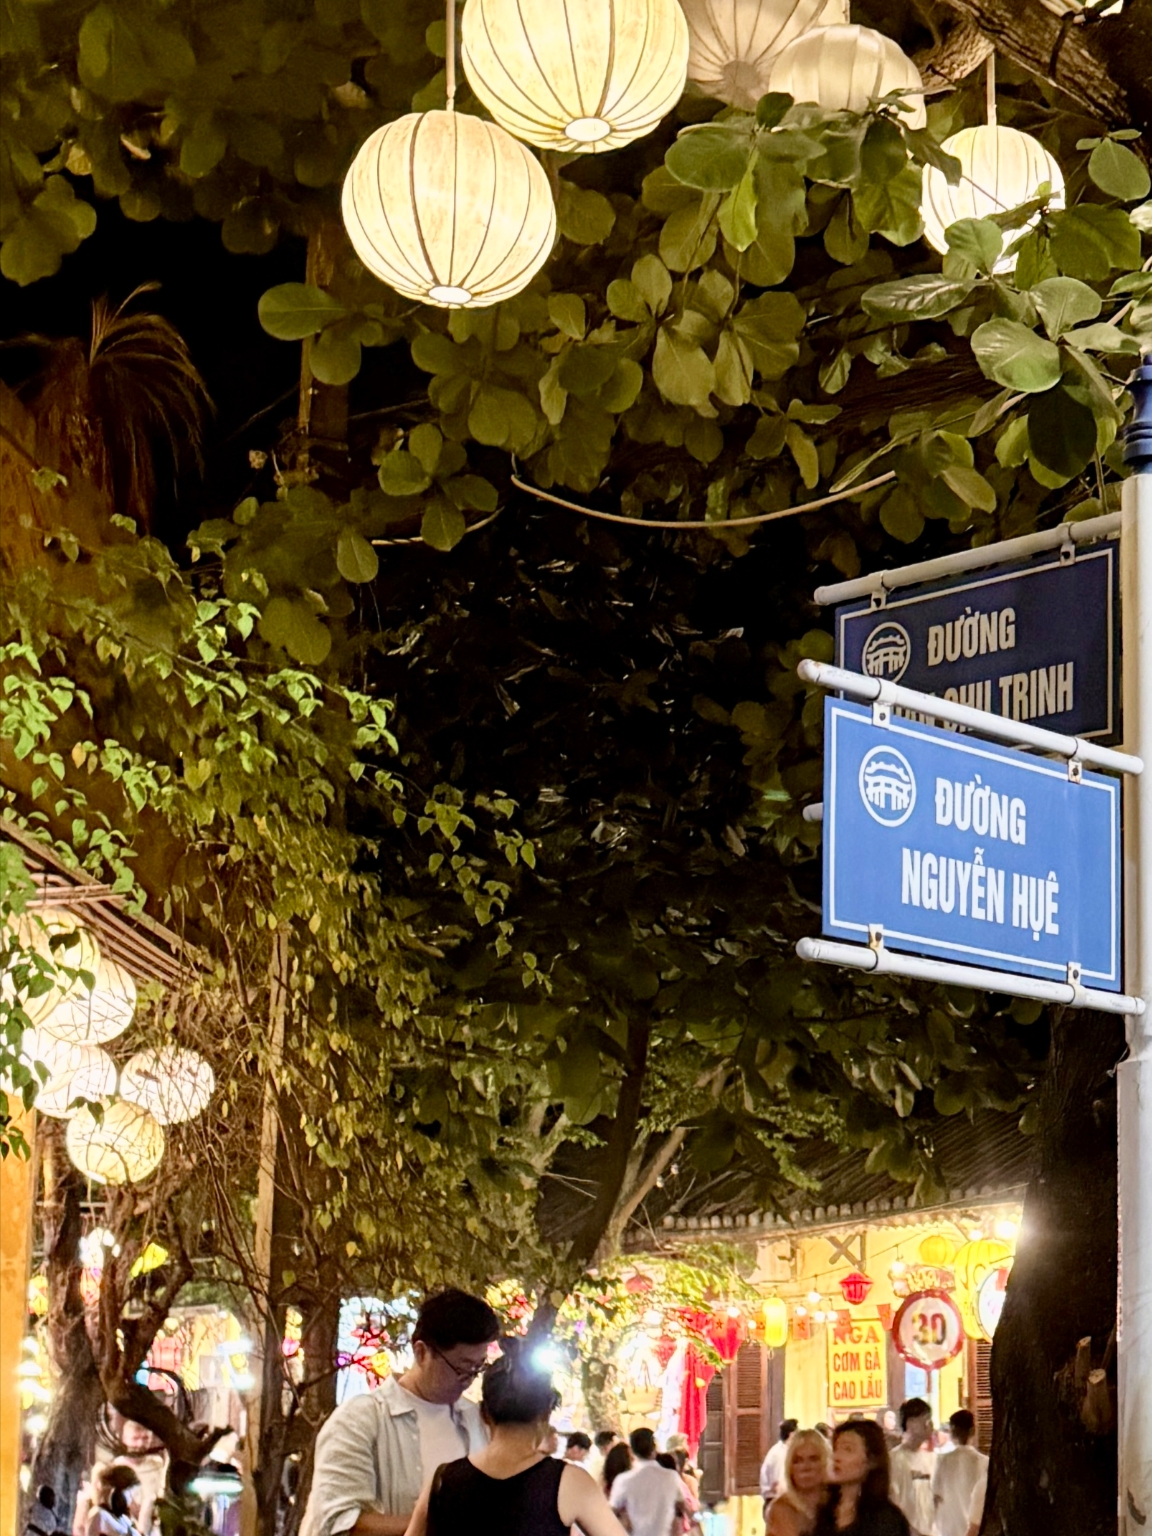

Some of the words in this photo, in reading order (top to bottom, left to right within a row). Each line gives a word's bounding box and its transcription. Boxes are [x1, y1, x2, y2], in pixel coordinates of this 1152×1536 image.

[927, 606, 1017, 667] ĐƯỜNG
[999, 661, 1074, 721] TRINH
[935, 773, 1026, 846] ĐƯỜNG
[901, 847, 1005, 925] NGUYỄN
[834, 1351, 861, 1372] CƠM
[864, 1346, 881, 1371] GÀ
[912, 1313, 947, 1345] 30
[833, 1380, 856, 1400] CAO
